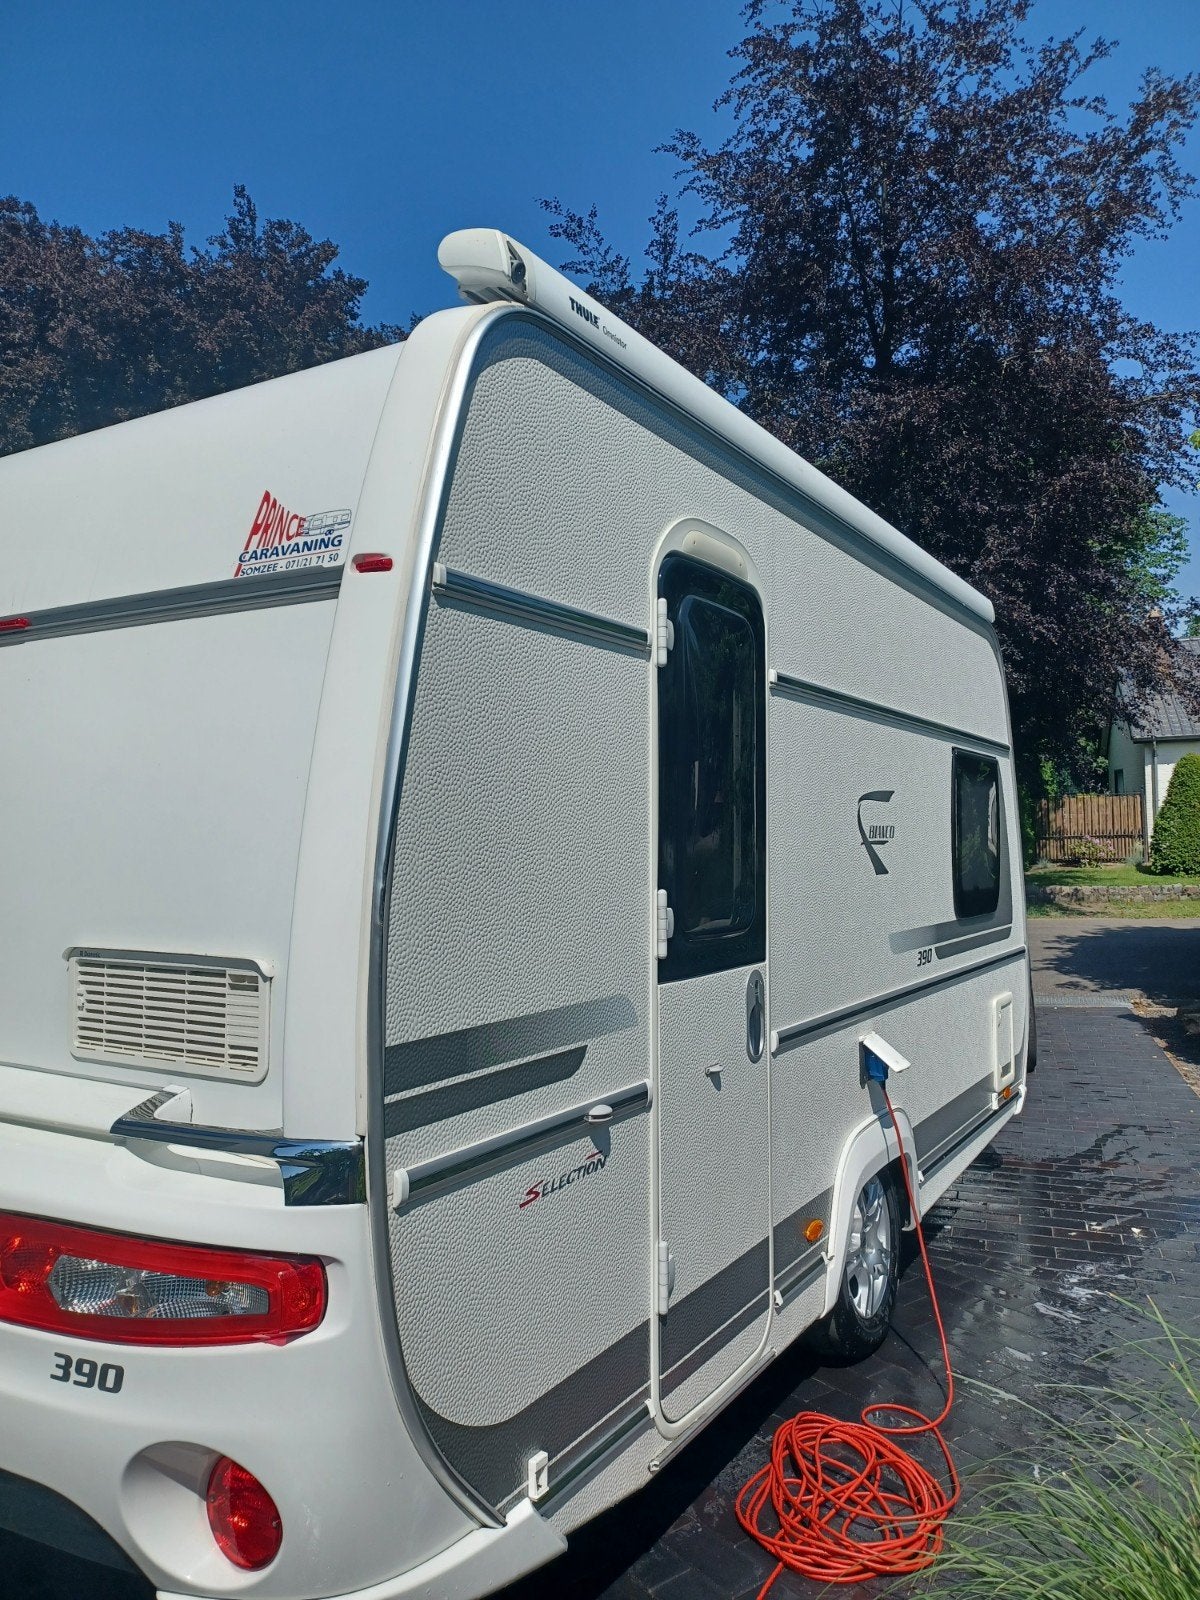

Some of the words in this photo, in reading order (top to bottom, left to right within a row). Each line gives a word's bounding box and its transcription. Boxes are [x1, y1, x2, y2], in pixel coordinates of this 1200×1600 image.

[568, 296, 600, 330] THULE
[242, 490, 307, 553] PRINCE
[239, 535, 343, 563] CARAVANING
[240, 562, 279, 577] SOMZEE
[286, 556, 312, 570] 071/21
[315, 555, 325, 565] 71
[328, 552, 339, 563] 50
[869, 825, 895, 839] BIANCO
[916, 948, 933, 967] 390
[519, 1152, 608, 1209] SELECTION
[50, 1351, 125, 1394] 390
